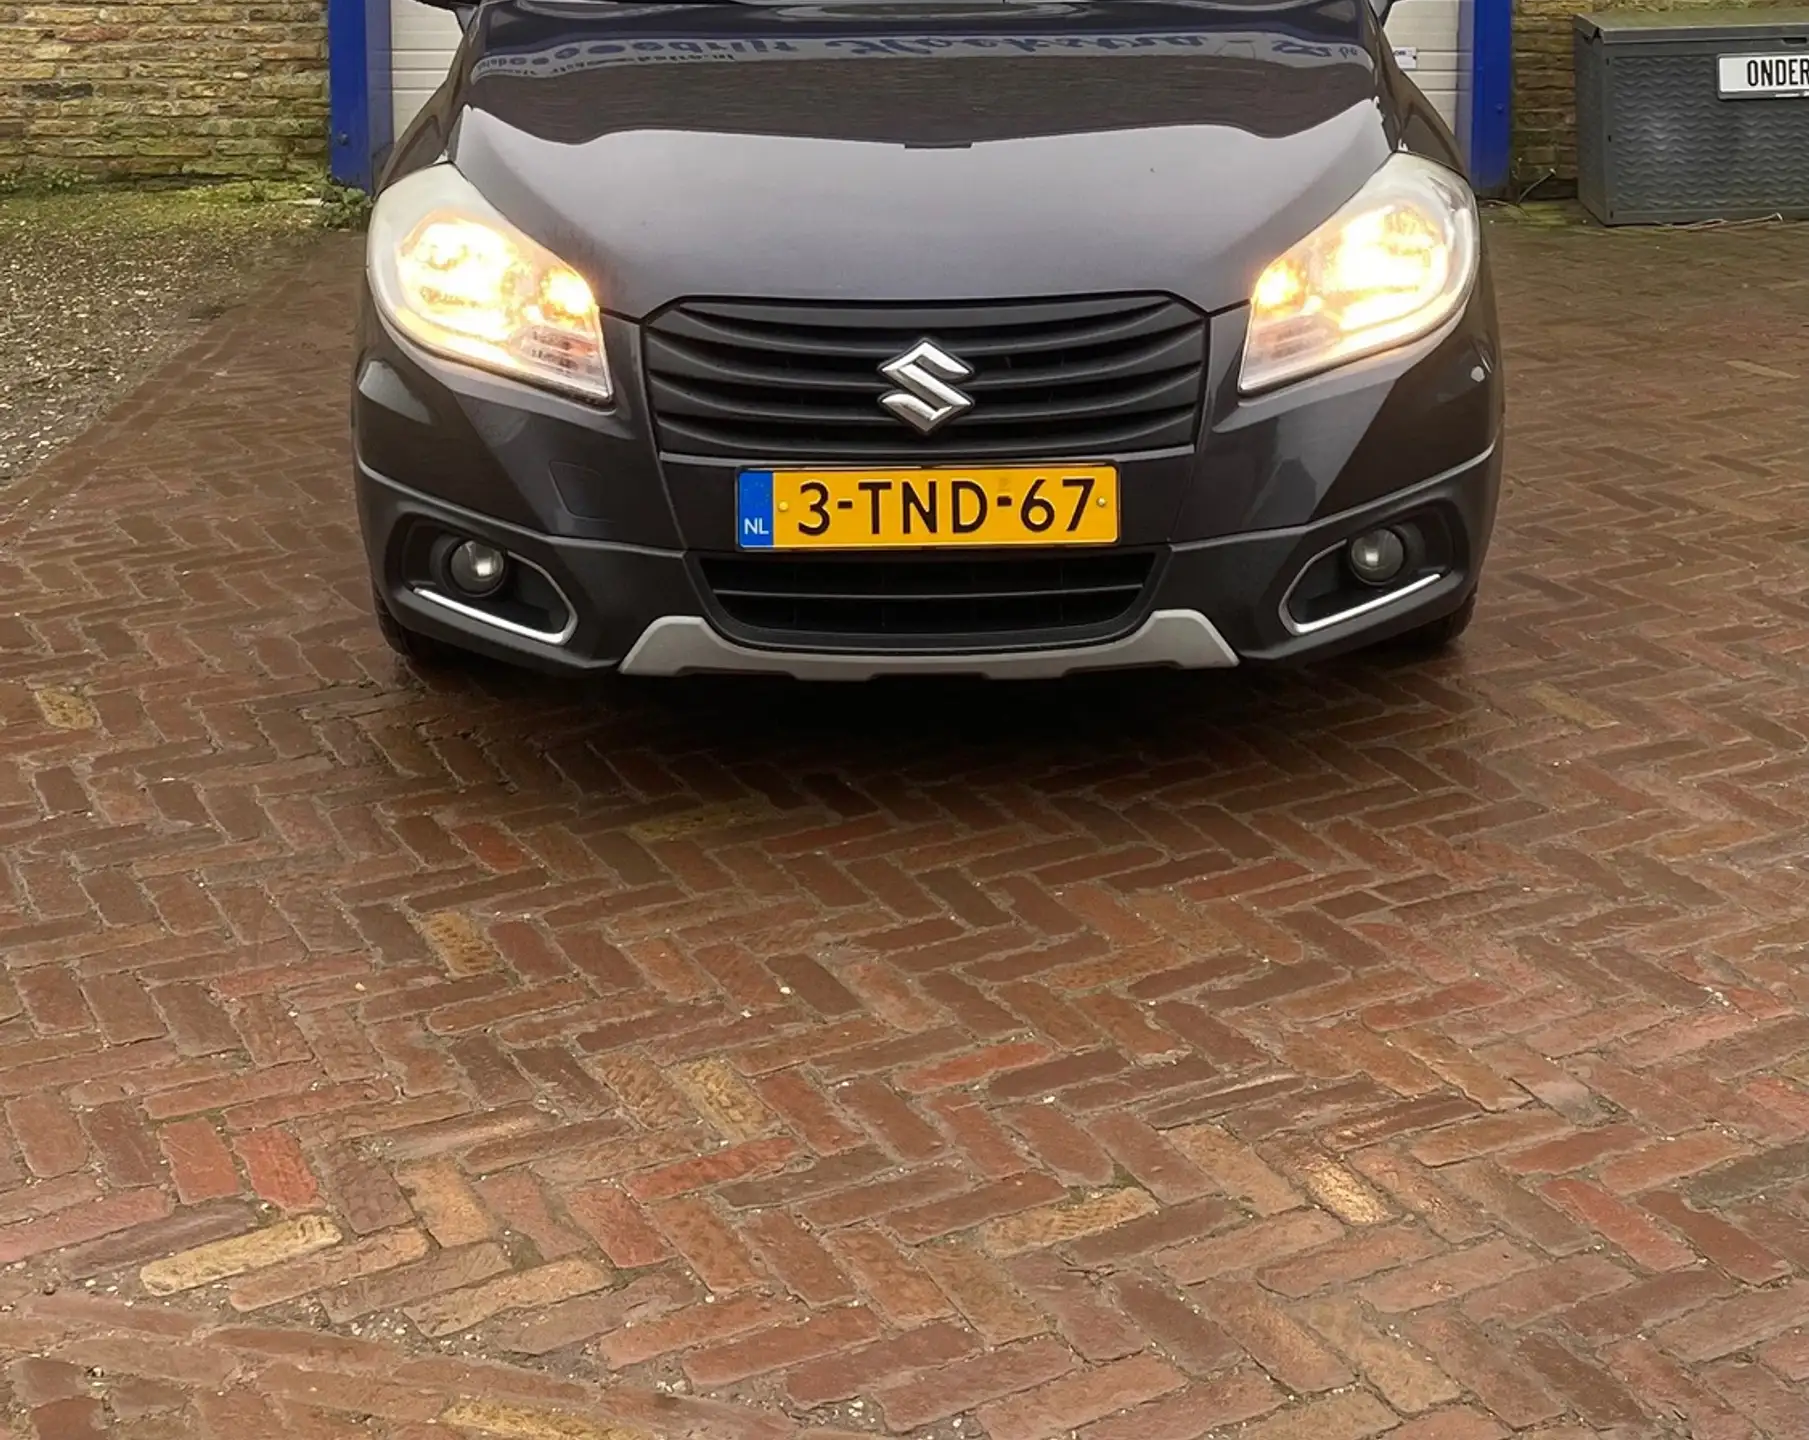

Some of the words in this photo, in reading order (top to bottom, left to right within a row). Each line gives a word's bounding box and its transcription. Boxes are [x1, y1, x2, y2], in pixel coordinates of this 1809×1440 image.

[1746, 58, 1809, 86] ONDER
[744, 519, 769, 535] NL
[798, 478, 1095, 536] 3-TND-67
